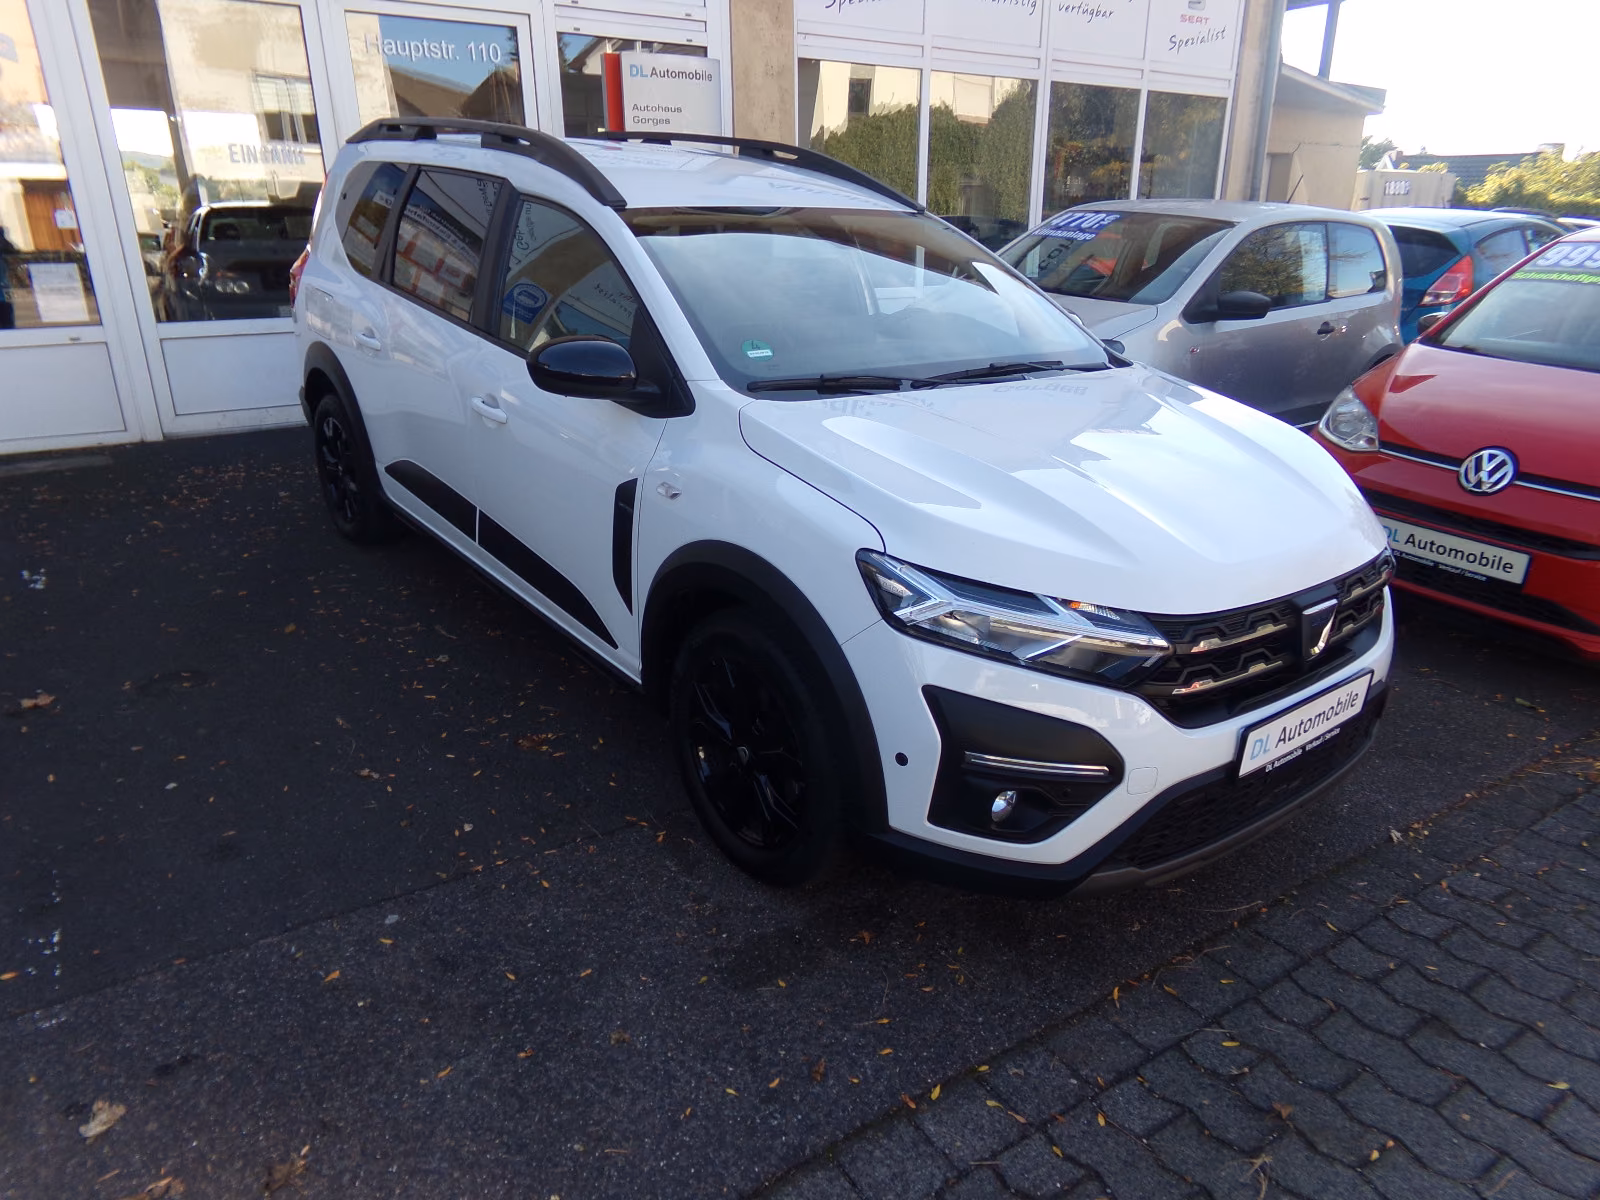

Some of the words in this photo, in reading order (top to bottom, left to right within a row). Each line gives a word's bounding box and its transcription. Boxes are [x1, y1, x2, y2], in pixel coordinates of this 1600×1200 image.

[1058, 1, 1115, 23] verfügbar
[1179, 13, 1210, 25] SEAT
[364, 33, 460, 62] Hauptstr.
[467, 41, 501, 63] 110
[1168, 25, 1227, 54] Spezialist
[629, 63, 649, 78] DL
[649, 66, 713, 82] Automobile
[631, 103, 683, 113] Autohaus
[632, 115, 671, 126] Gorges
[1404, 533, 1514, 574] Automobile
[1249, 733, 1271, 761] DL
[1274, 689, 1359, 749] Automobile
